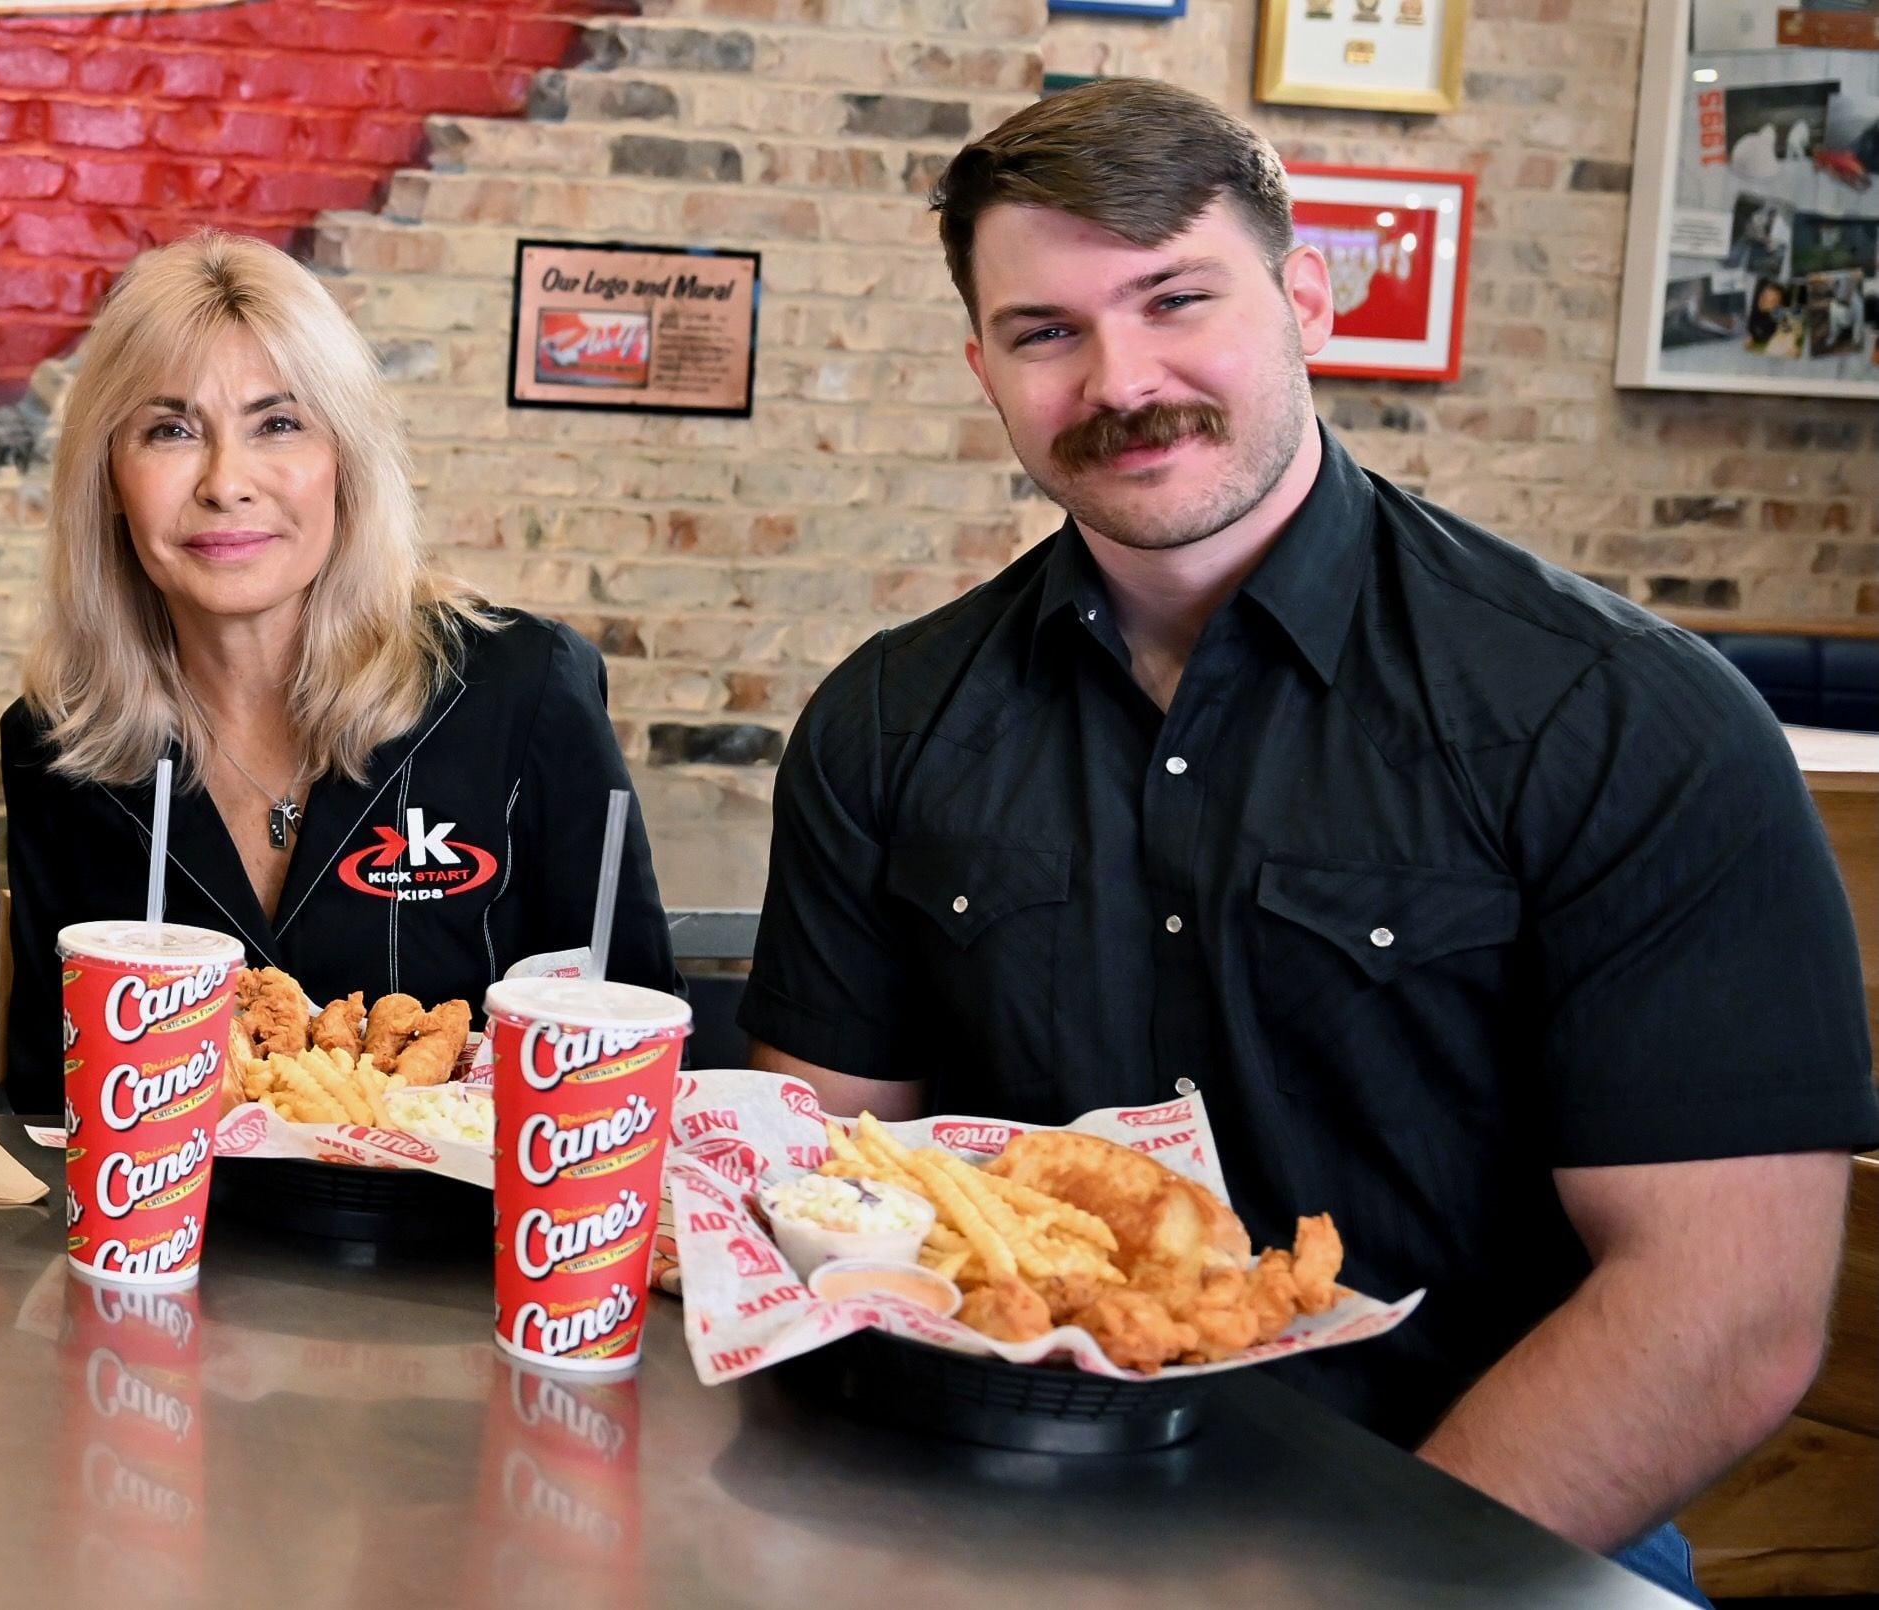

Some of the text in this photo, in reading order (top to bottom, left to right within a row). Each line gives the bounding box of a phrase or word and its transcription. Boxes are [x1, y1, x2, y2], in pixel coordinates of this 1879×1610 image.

[1697, 89, 1729, 168] 1995
[542, 267, 736, 300] Our Logo and Mural
[368, 869, 470, 883] KICK START
[397, 888, 444, 901] KIDS
[160, 1015, 198, 1032] CHICKEN
[142, 1053, 191, 1076] Raising
[100, 1039, 221, 1131] Cane's
[153, 1103, 189, 1120] CHICKEN
[681, 1110, 740, 1139] ONE
[135, 1141, 183, 1165] Raising
[517, 1094, 658, 1185] Cane's
[1130, 1130, 1193, 1153] OVE
[96, 1127, 211, 1219] Cane's
[145, 1191, 181, 1208] CHICKEN
[93, 1215, 201, 1274] Cane's
[515, 1189, 648, 1279] Cane's
[512, 1283, 638, 1357] Cane's
